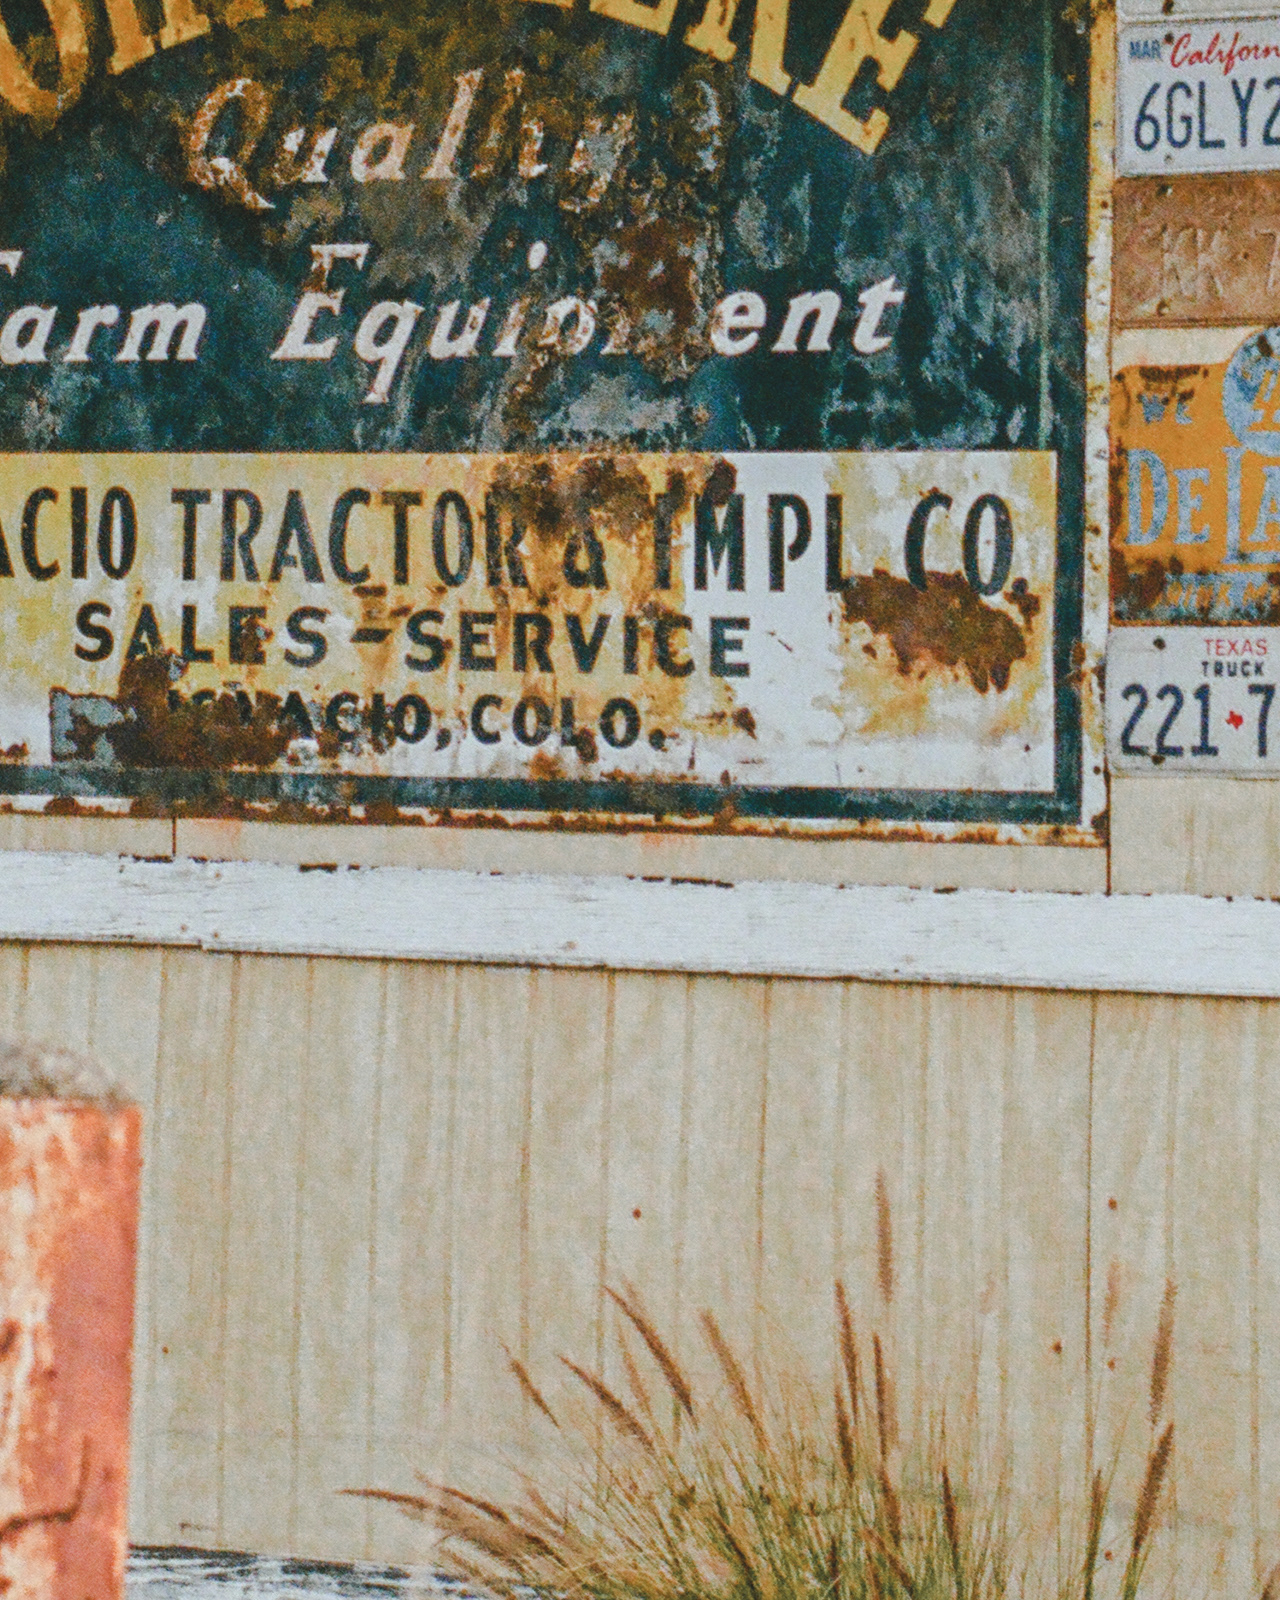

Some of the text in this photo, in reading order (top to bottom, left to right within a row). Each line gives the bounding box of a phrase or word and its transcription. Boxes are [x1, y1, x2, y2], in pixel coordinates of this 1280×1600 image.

[170, 487, 530, 592] TRACTOR
[903, 493, 1014, 597] CO
[1201, 661, 1266, 679] TRUCK
[1203, 638, 1269, 658] TEXAS
[1120, 683, 1221, 757] 221
